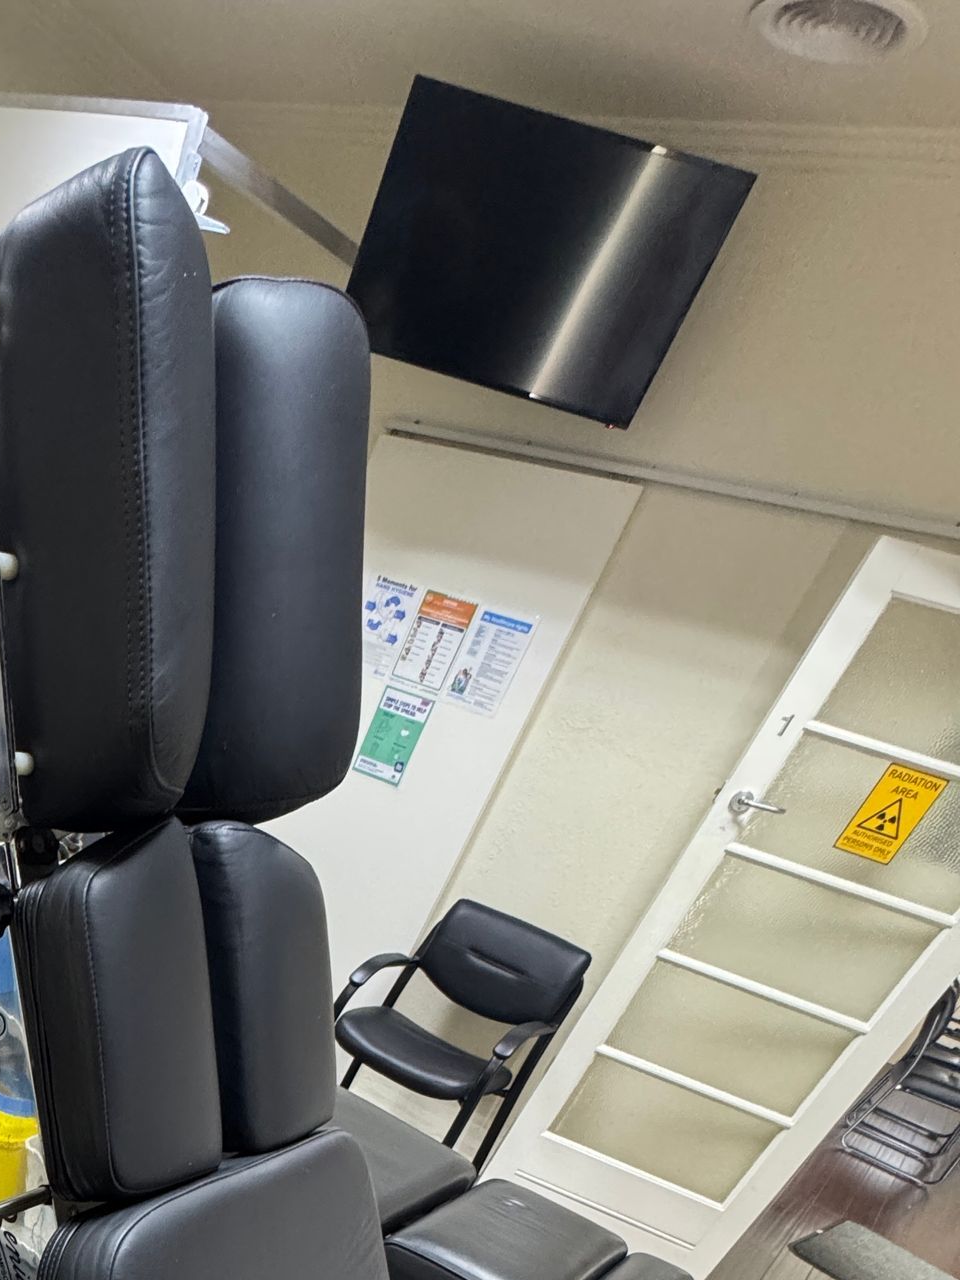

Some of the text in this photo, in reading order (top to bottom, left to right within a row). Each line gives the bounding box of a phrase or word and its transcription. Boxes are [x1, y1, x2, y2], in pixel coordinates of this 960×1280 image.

[382, 576, 408, 590] Moments
[409, 584, 418, 592] for
[888, 769, 942, 792] RADIATION
[890, 786, 920, 801] AREA
[843, 836, 874, 851] PERSONS
[873, 846, 892, 856] ONLY
[851, 830, 894, 848] AUTHORISED
